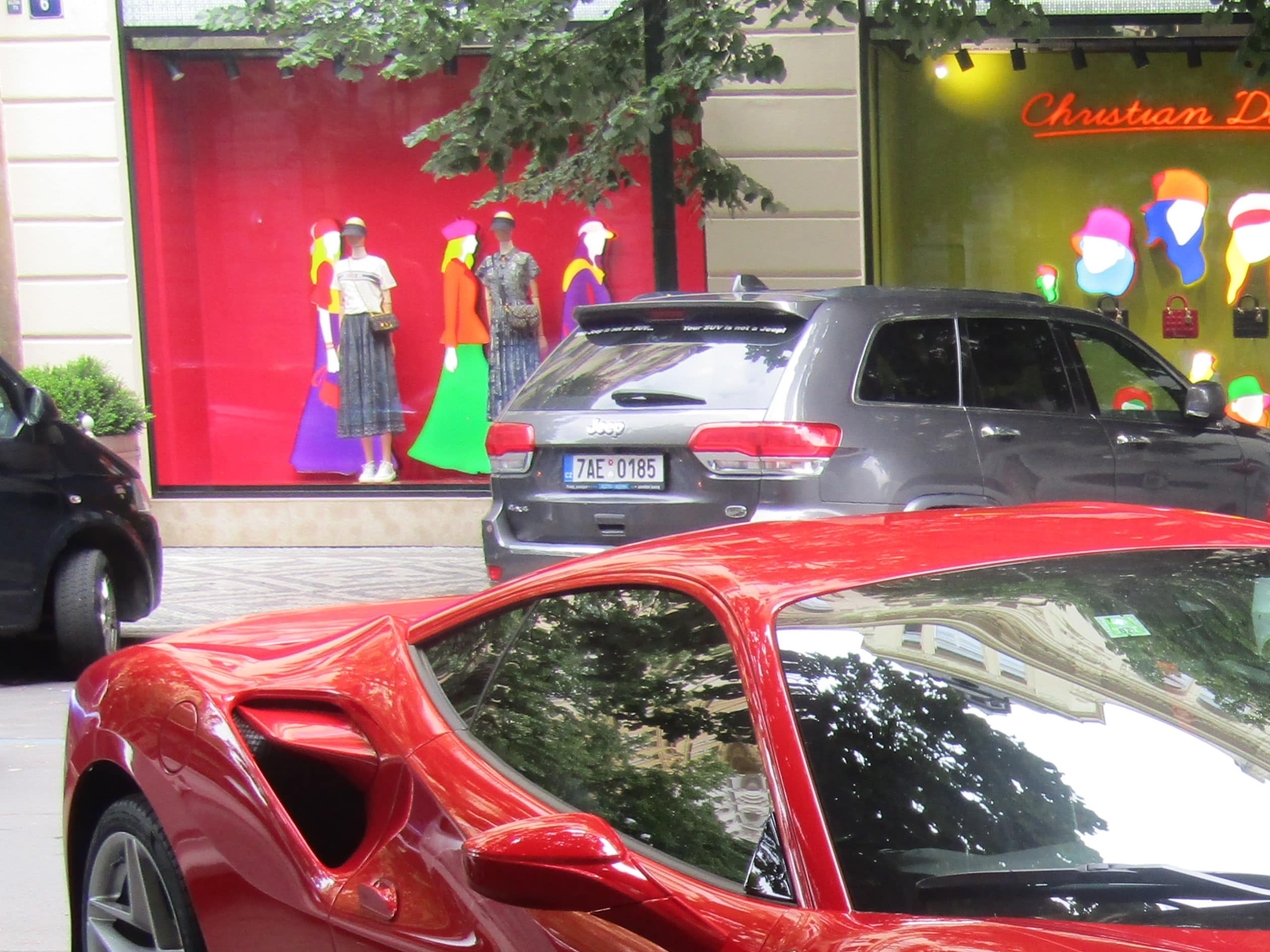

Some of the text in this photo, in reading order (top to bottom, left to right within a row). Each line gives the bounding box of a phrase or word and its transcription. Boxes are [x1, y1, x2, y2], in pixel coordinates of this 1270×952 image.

[1021, 92, 1213, 127] Christian
[759, 326, 787, 334] Jeep!
[586, 418, 625, 439] Jeep
[577, 458, 656, 479] 7AE 0185
